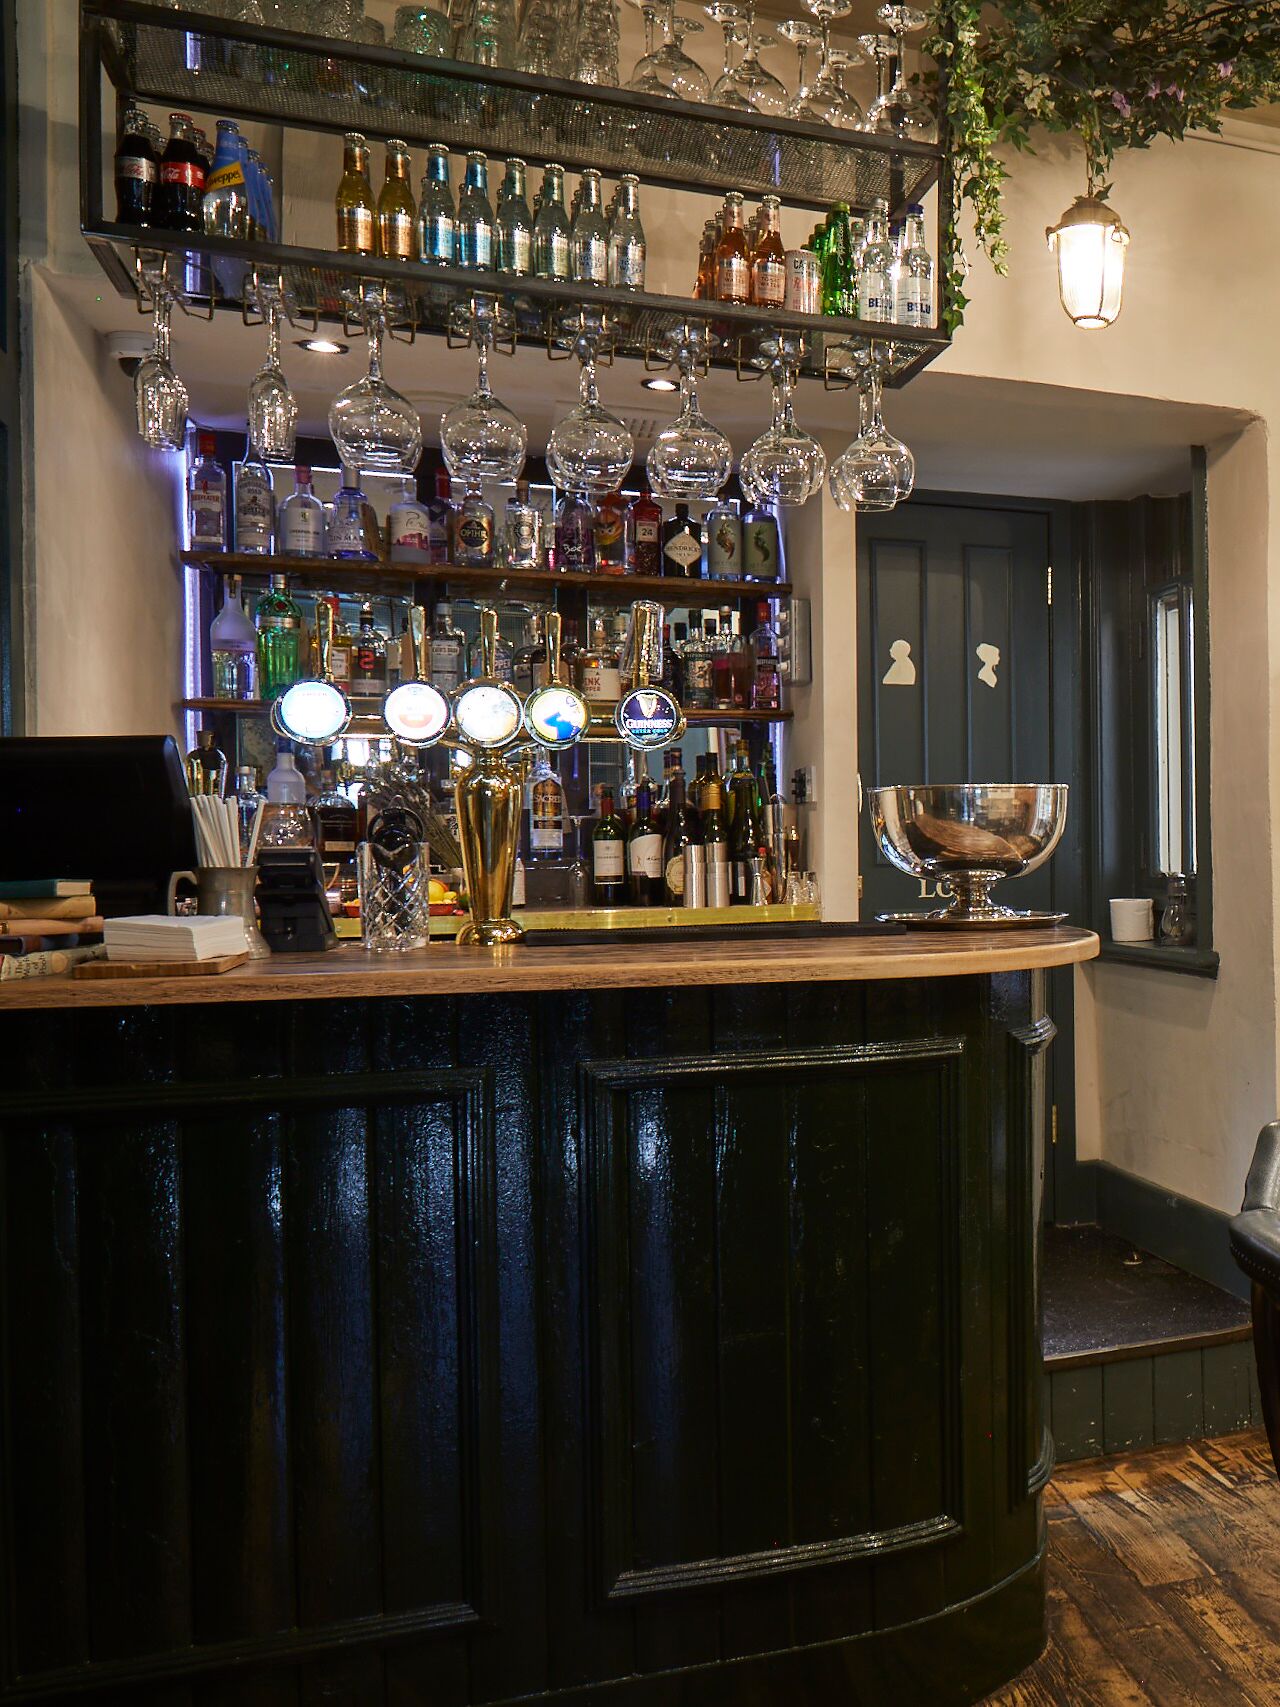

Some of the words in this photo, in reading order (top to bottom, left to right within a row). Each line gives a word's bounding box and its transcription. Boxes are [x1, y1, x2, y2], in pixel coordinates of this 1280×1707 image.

[907, 302, 931, 314] BELU
[641, 527, 653, 537] 24
[584, 677, 600, 686] INK
[626, 718, 673, 729] GUINNESS
